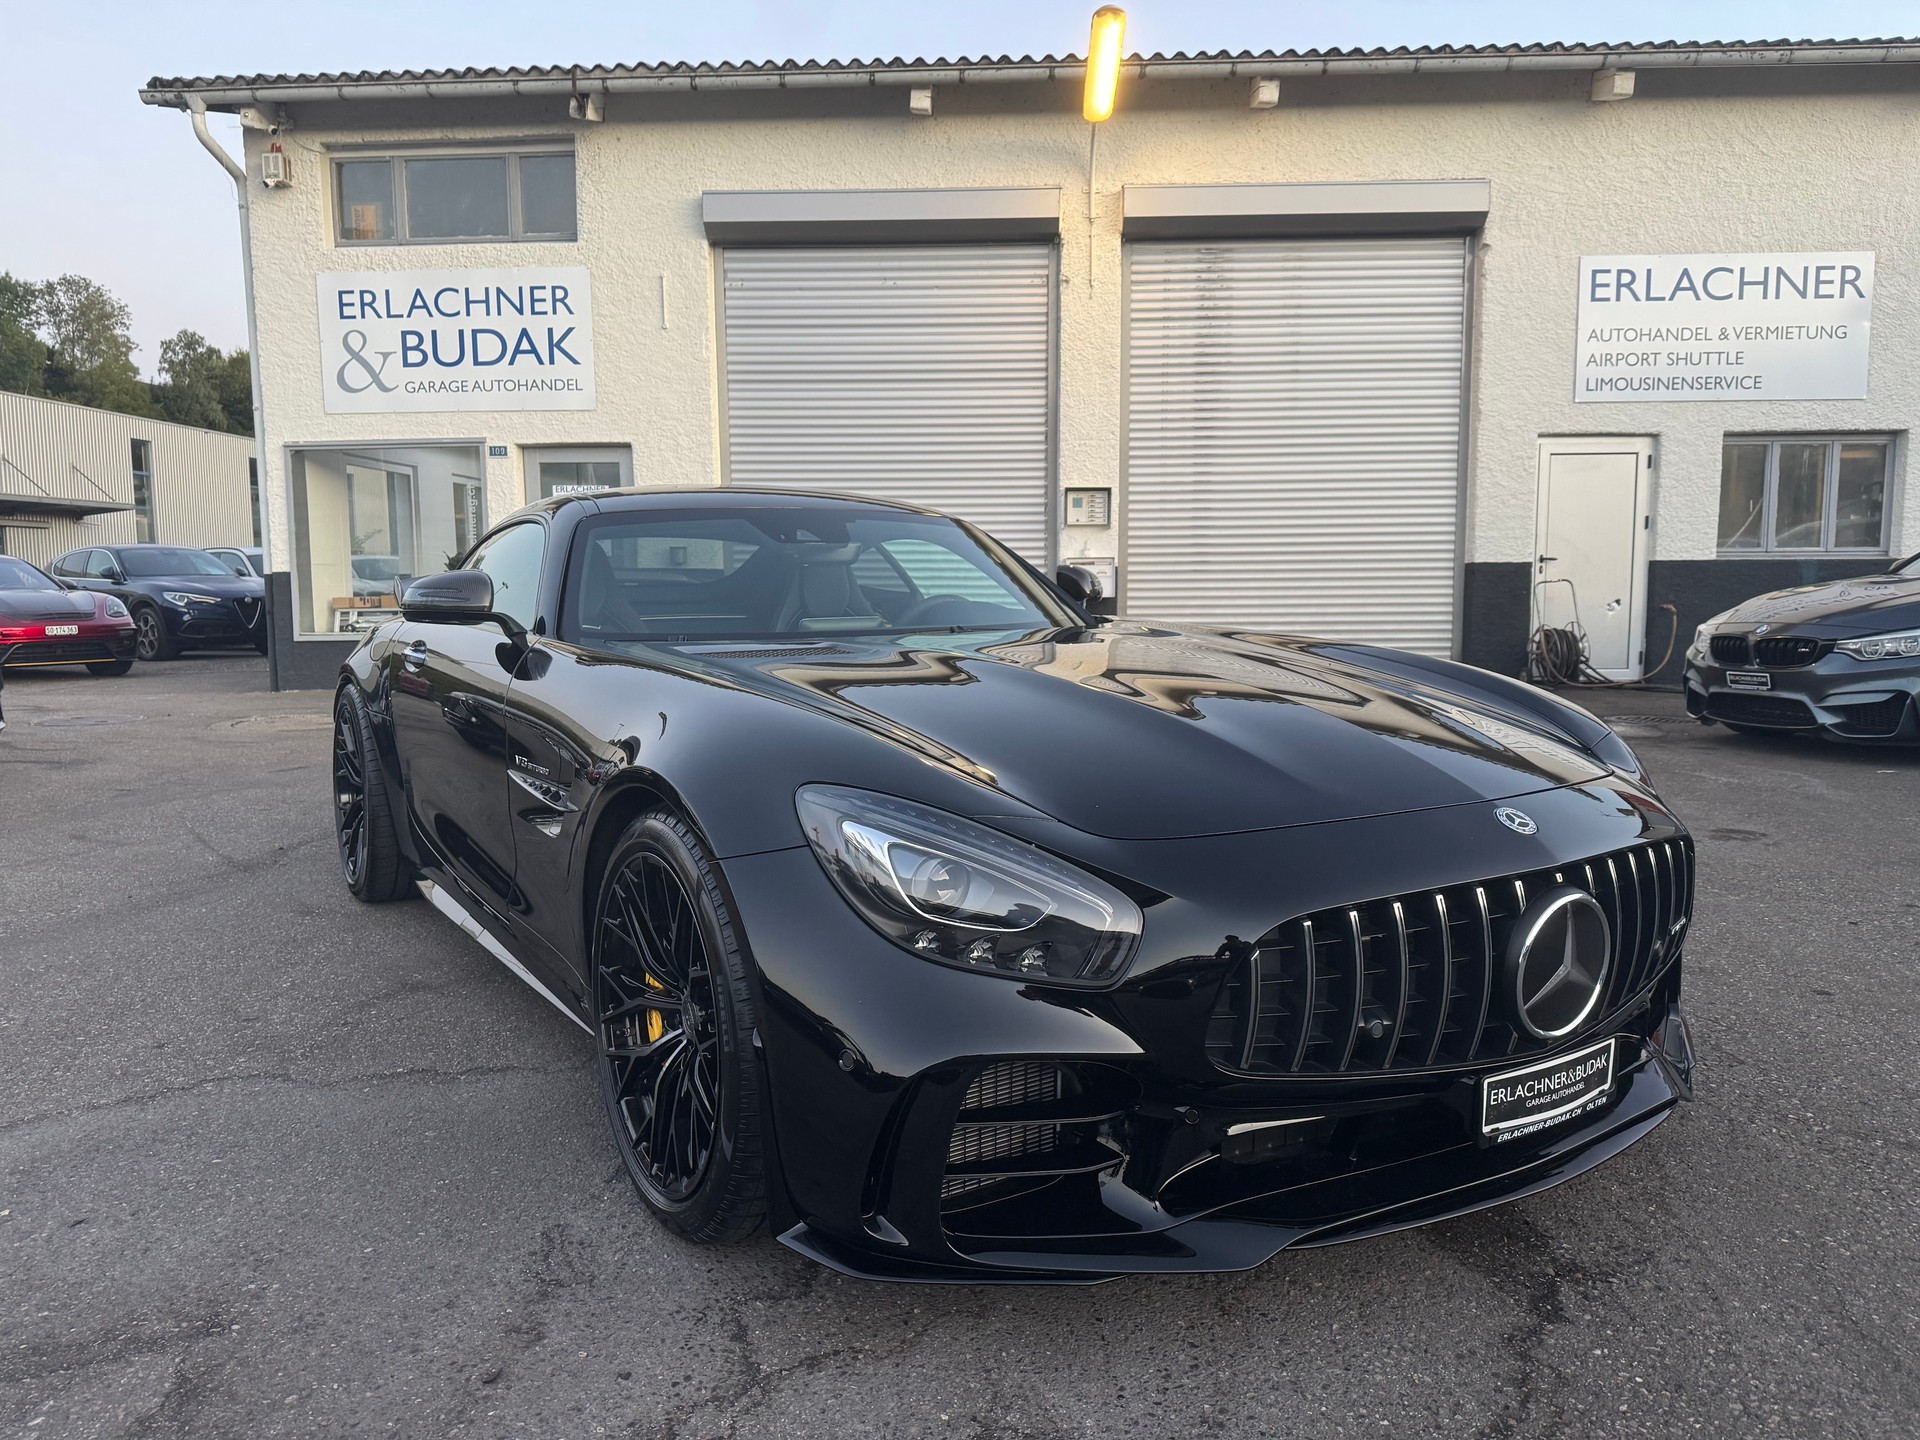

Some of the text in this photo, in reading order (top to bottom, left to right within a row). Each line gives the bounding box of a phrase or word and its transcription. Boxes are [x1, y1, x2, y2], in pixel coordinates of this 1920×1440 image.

[1589, 264, 1866, 303] ERLACHNER
[337, 285, 575, 320] ERLACHNER
[1587, 326, 1713, 343] AUTOHANDEL
[1733, 325, 1848, 341] VERMIETUNG
[336, 326, 582, 394] & BUDAK
[1586, 351, 1745, 368] AIRPORT SHUTTLE
[404, 378, 584, 394] GARAGE AUTOHANDEL
[1585, 375, 1763, 392] LIMOUSINENSERVICE
[491, 447, 505, 455] 109
[1526, 1082, 1586, 1108] GARAGE AUTOHANDEL
[1497, 1096, 1608, 1143] ERLACHNER-BUDAK.CH OLTEN
